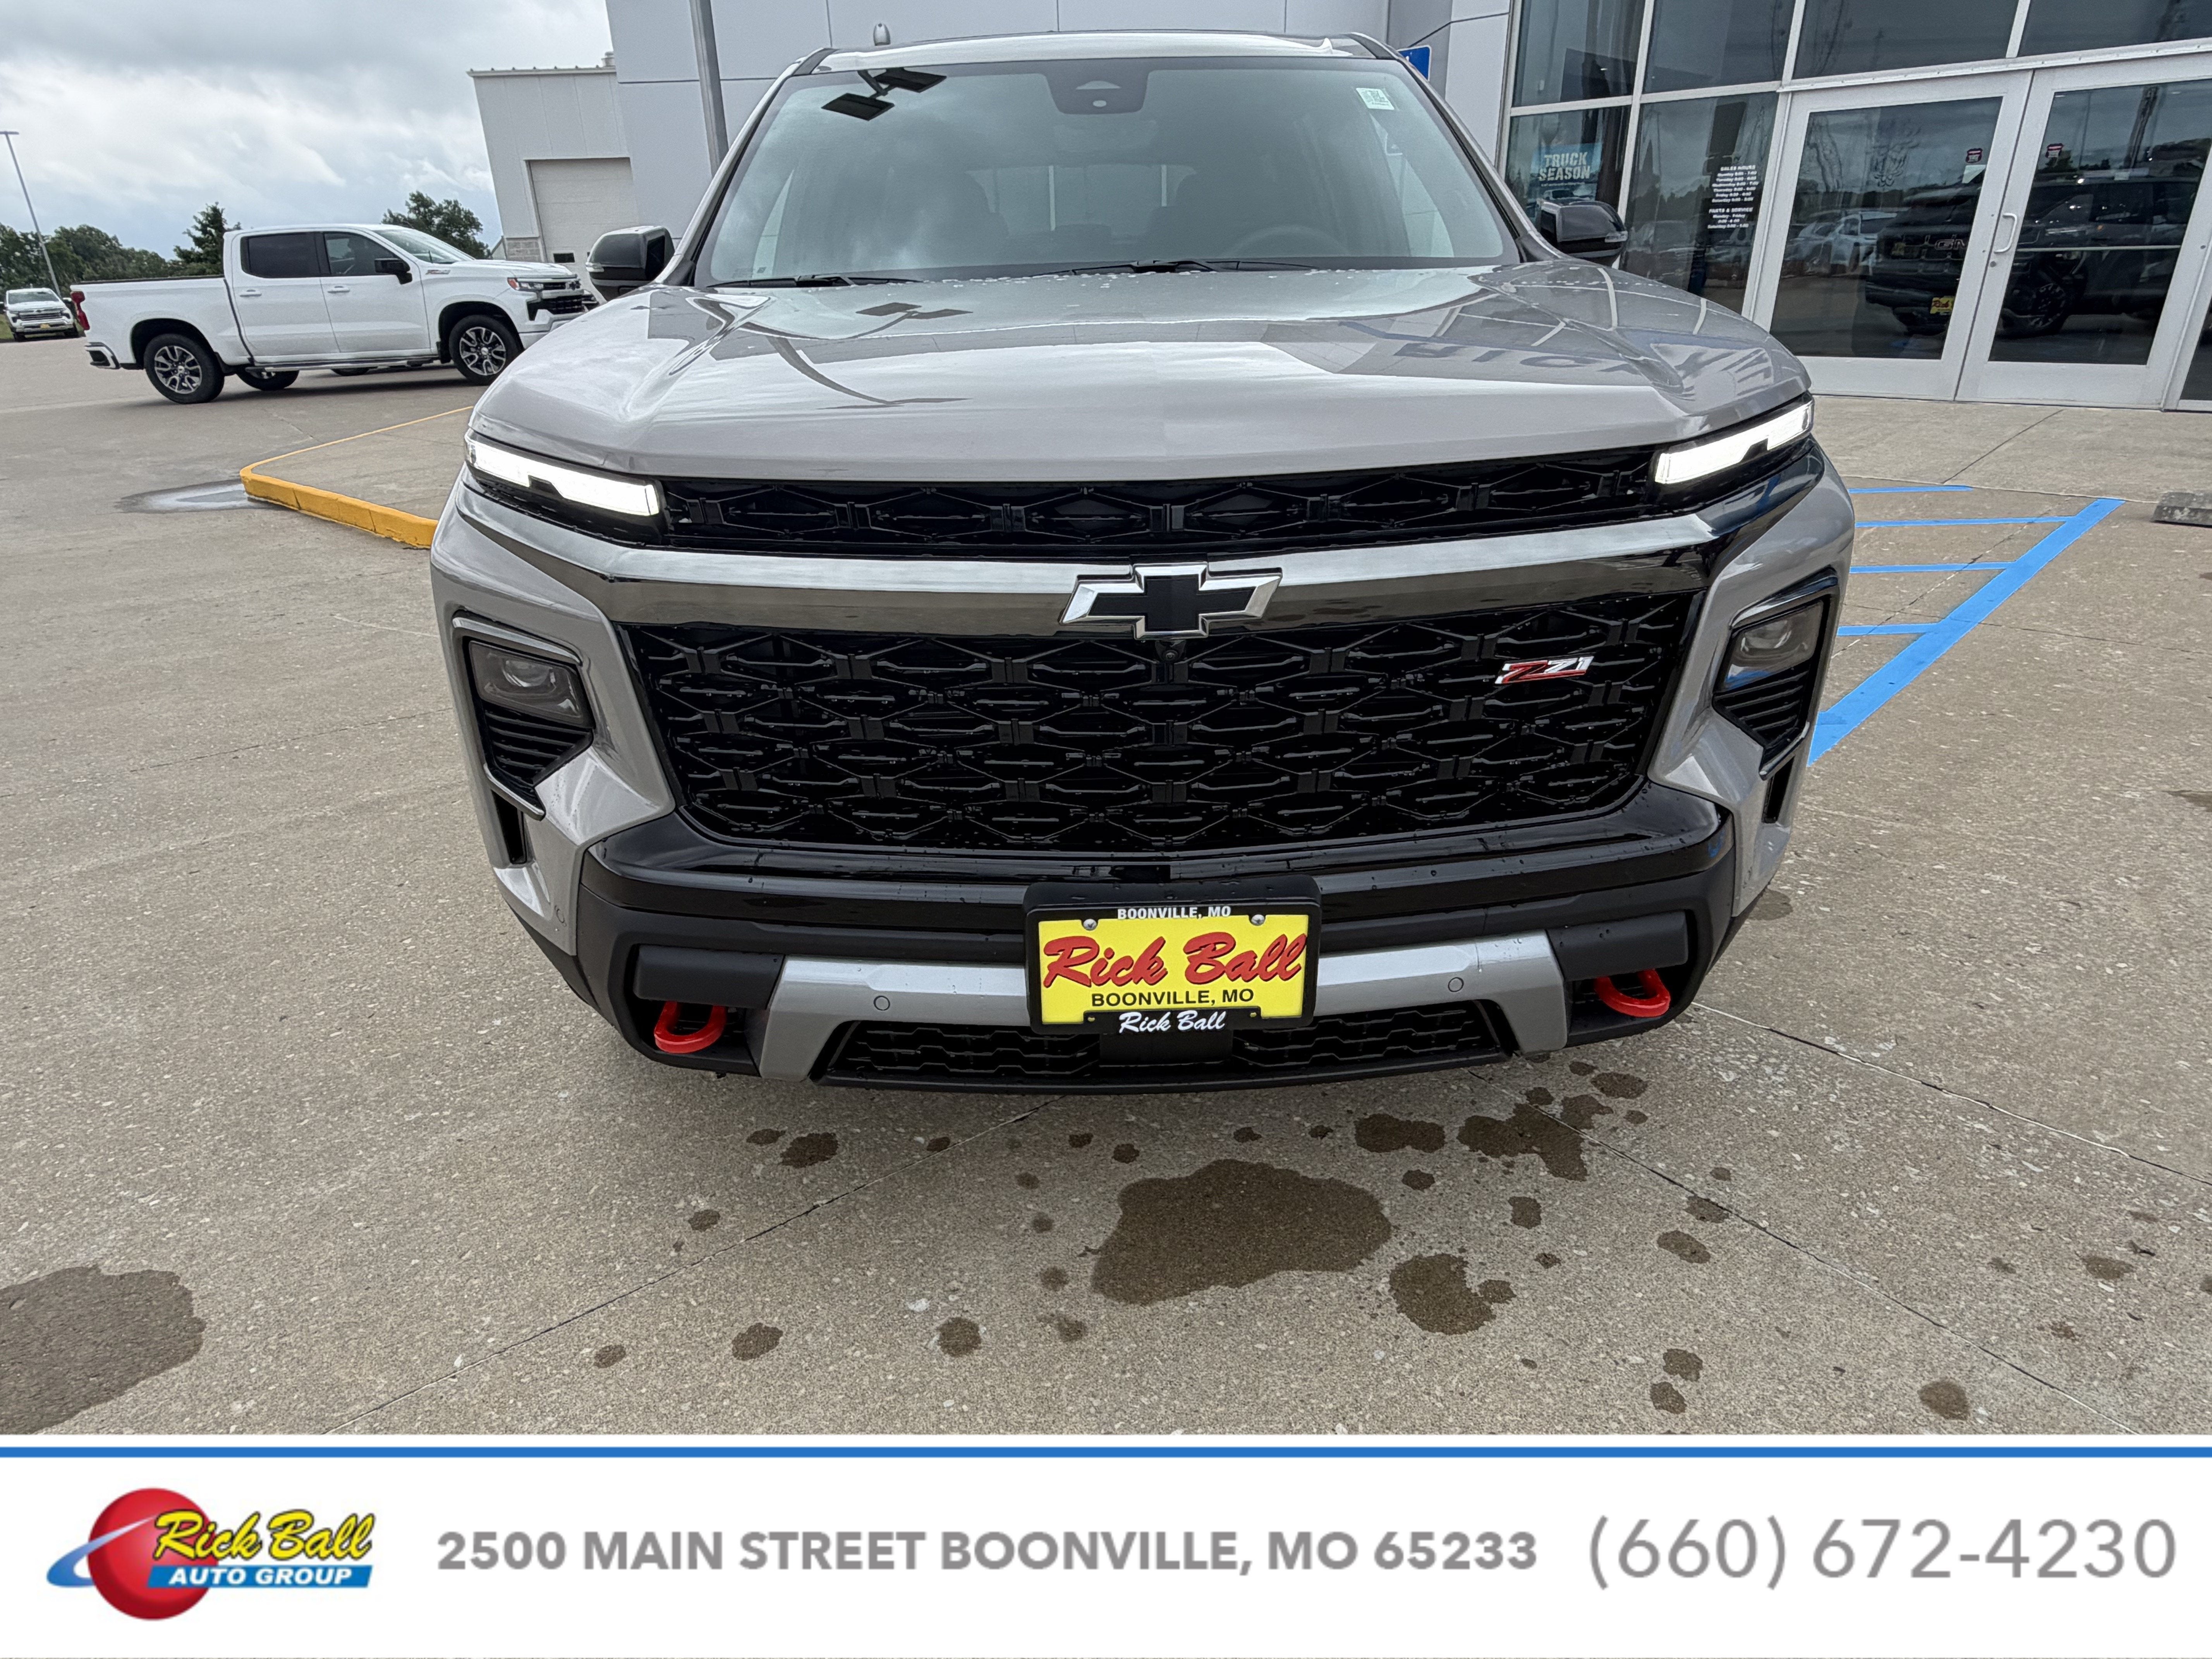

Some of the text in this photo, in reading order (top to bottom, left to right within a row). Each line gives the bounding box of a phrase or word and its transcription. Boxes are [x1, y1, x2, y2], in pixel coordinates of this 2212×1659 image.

[1544, 151, 1588, 167] TRUCK
[1538, 165, 1590, 181] SEASON
[1495, 656, 1594, 684] Z71
[1118, 906, 1231, 919] BOONVILLE, MO
[1043, 932, 1307, 988] Rick Ball
[1092, 988, 1254, 1006] BOONVILLE, MO
[1119, 1010, 1226, 1034] Rick Ball
